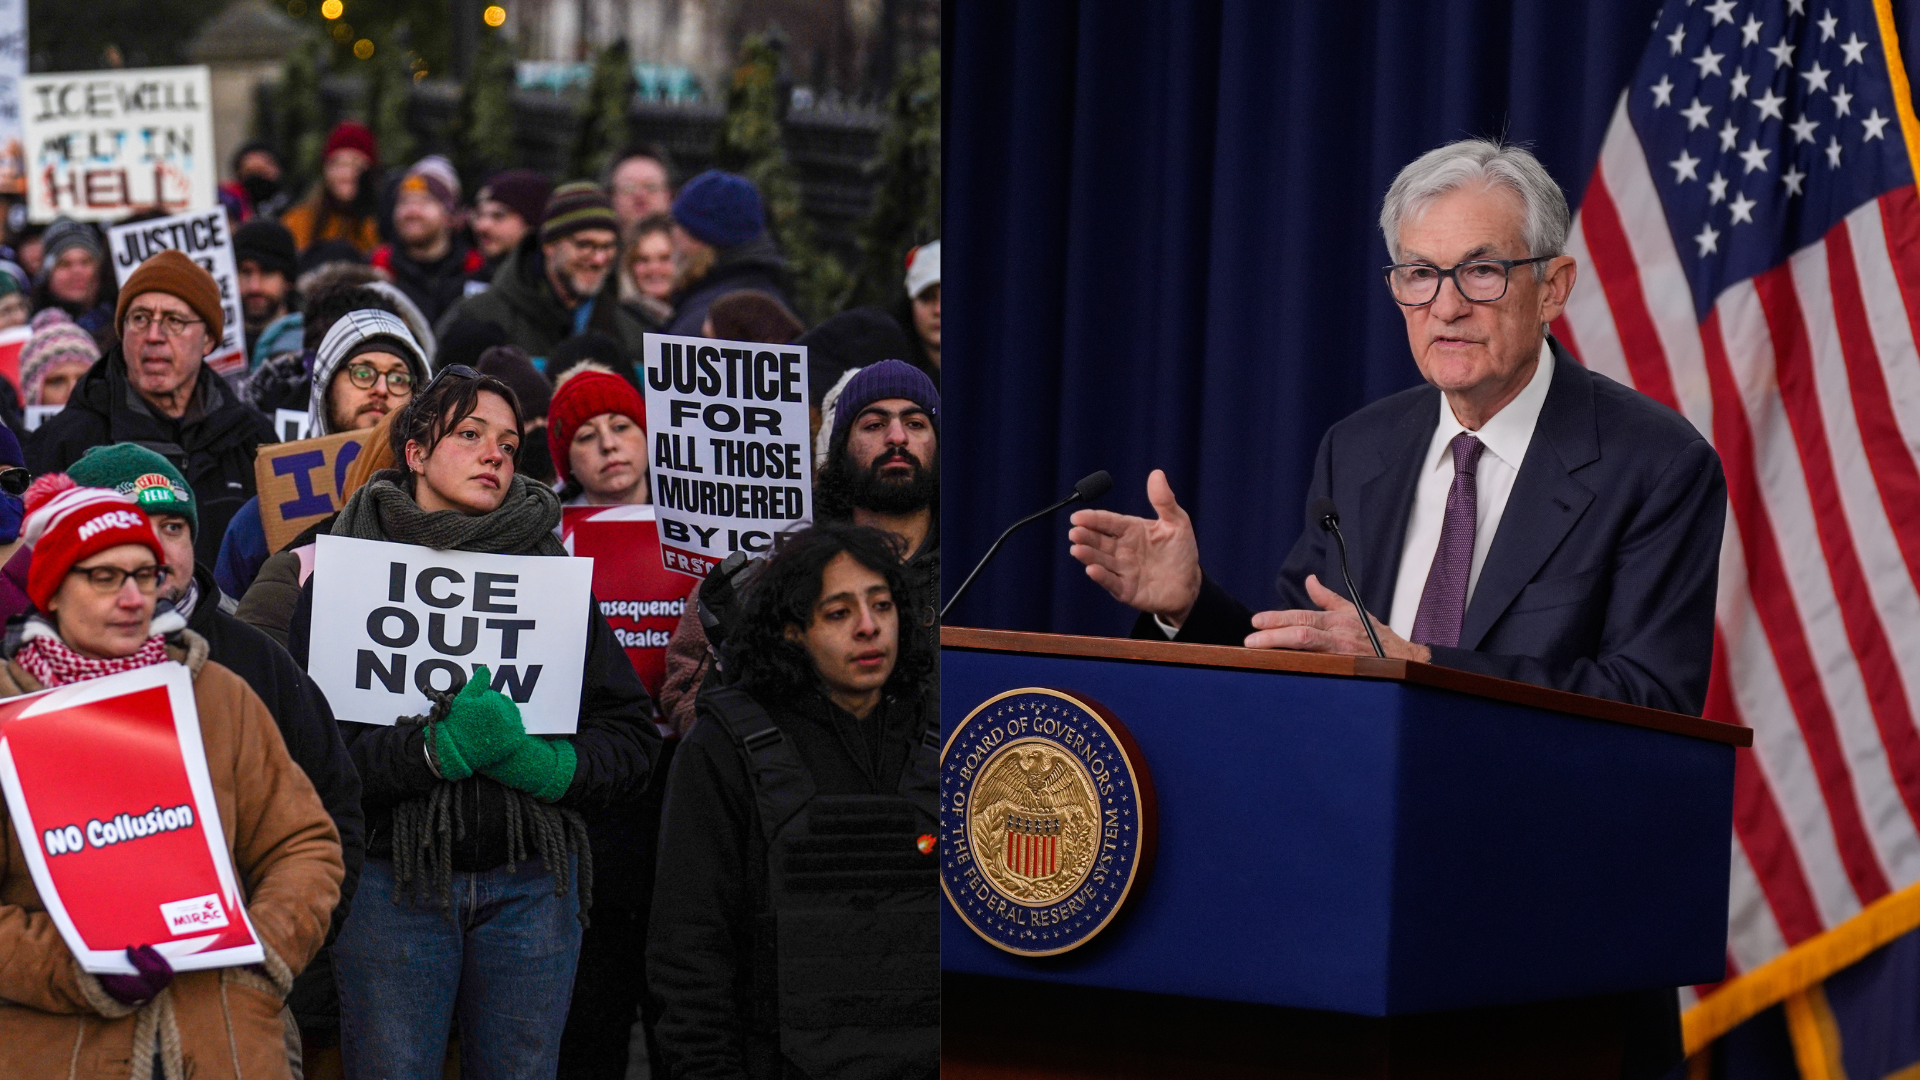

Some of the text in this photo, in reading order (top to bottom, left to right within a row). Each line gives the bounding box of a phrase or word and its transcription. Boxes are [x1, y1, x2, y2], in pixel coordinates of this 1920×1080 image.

[34, 82, 114, 123] ICE
[139, 127, 194, 164] IN
[45, 165, 189, 212] HELL
[119, 214, 224, 266] JUSTICE
[648, 342, 802, 403] JUSTICE
[670, 399, 782, 436] FOR
[655, 432, 802, 480] ALL THOSE
[137, 474, 168, 489] CENTRAL
[657, 474, 803, 520] MURDERED
[662, 518, 720, 549] BY
[388, 561, 519, 614] ICE
[366, 606, 536, 659] OUT
[613, 627, 669, 648] Reales
[355, 648, 543, 703] NOW
[960, 716, 1114, 796] BOARD OF GOVERNORS
[44, 805, 194, 857] NO Collusion
[952, 792, 1119, 927] OF THE FEDERAL RESERVE SYSTEM
[173, 910, 221, 927] MIRAC
